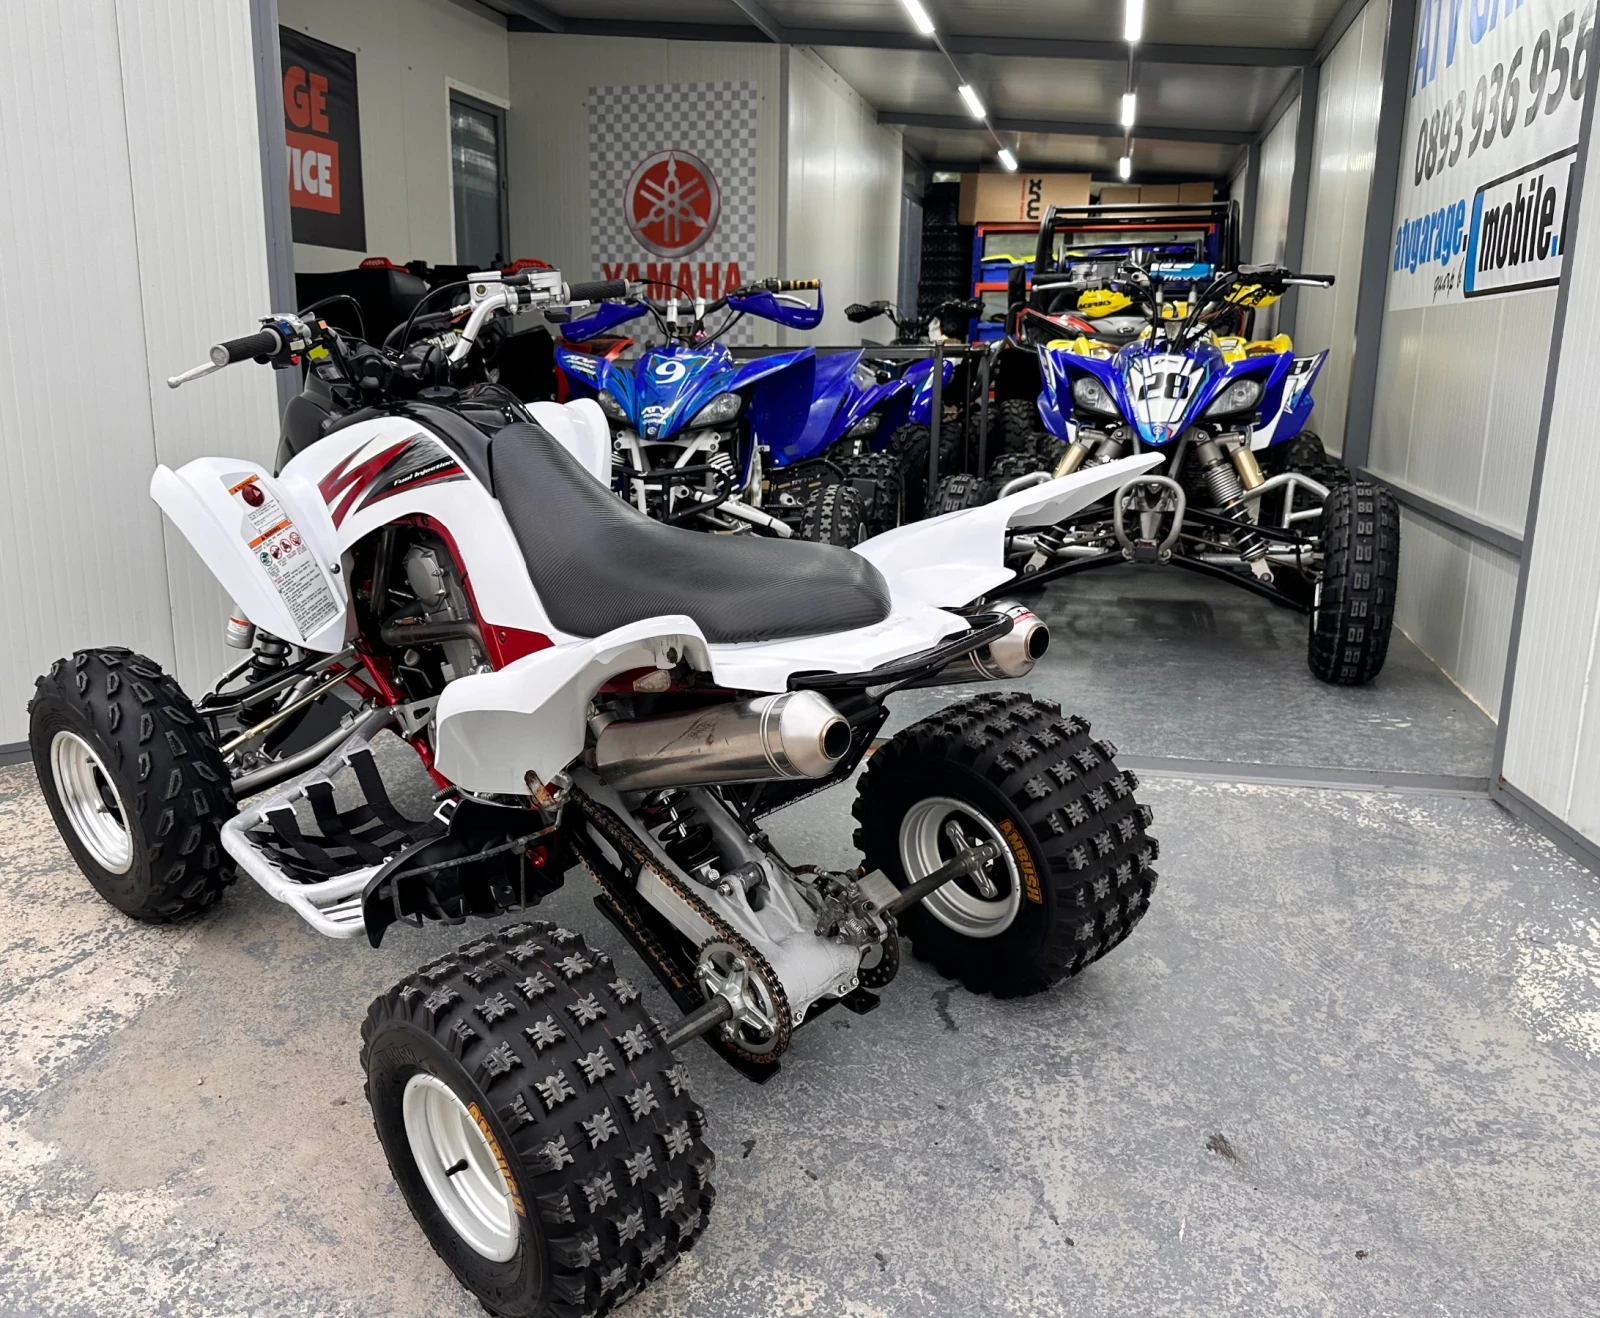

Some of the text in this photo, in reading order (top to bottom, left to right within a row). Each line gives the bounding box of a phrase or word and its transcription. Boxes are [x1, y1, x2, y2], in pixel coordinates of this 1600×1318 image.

[1414, 90, 1467, 186] 0893
[1468, 46, 1524, 158] 936
[1525, 2, 1595, 128] 956
[602, 262, 742, 301] YAMAHA
[655, 361, 686, 384] 9
[1137, 372, 1191, 401] 28
[394, 460, 455, 486] Fuel Injection
[998, 819, 1043, 904] AMBUSH
[467, 1101, 527, 1217] AMBUSH
